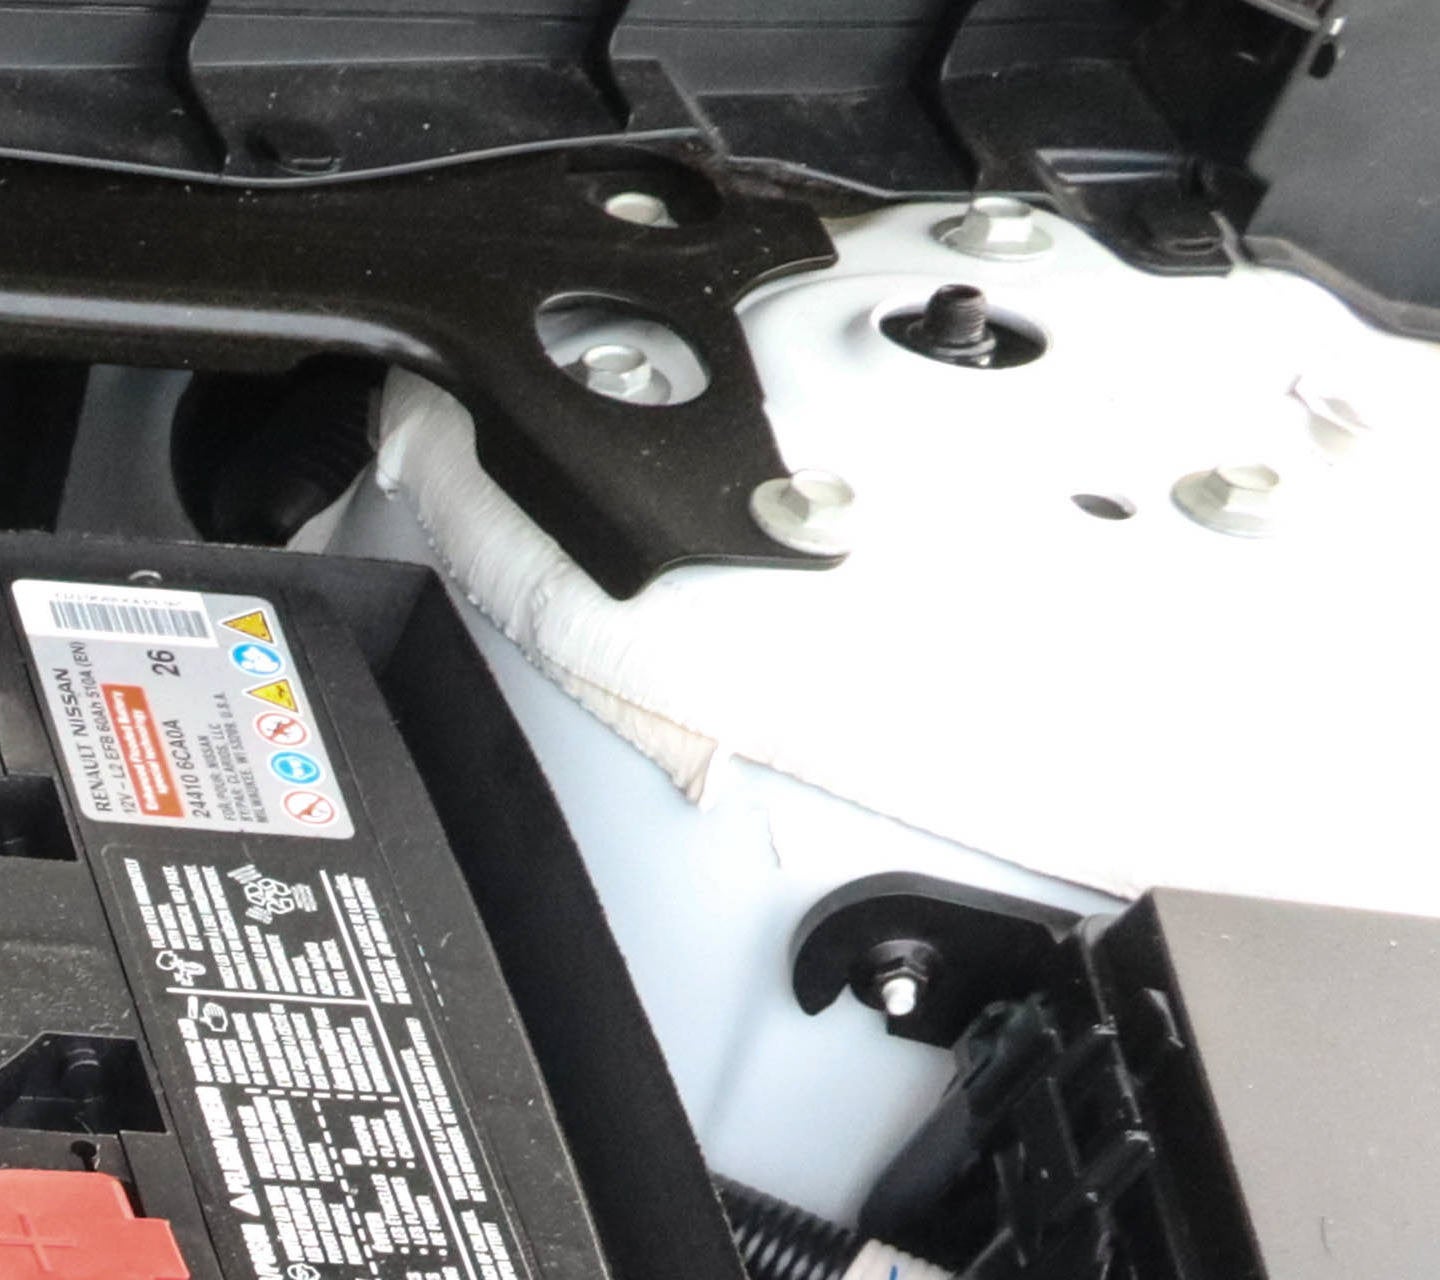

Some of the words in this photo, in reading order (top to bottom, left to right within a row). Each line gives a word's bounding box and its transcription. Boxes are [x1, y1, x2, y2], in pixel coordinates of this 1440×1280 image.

[68, 640, 91, 667] (EN)
[145, 648, 180, 677] 26
[51, 667, 89, 736] NISSAN
[98, 735, 121, 760] EFB
[76, 744, 113, 812] RENAULT
[116, 792, 138, 814] 12V
[179, 773, 211, 818] 24410
